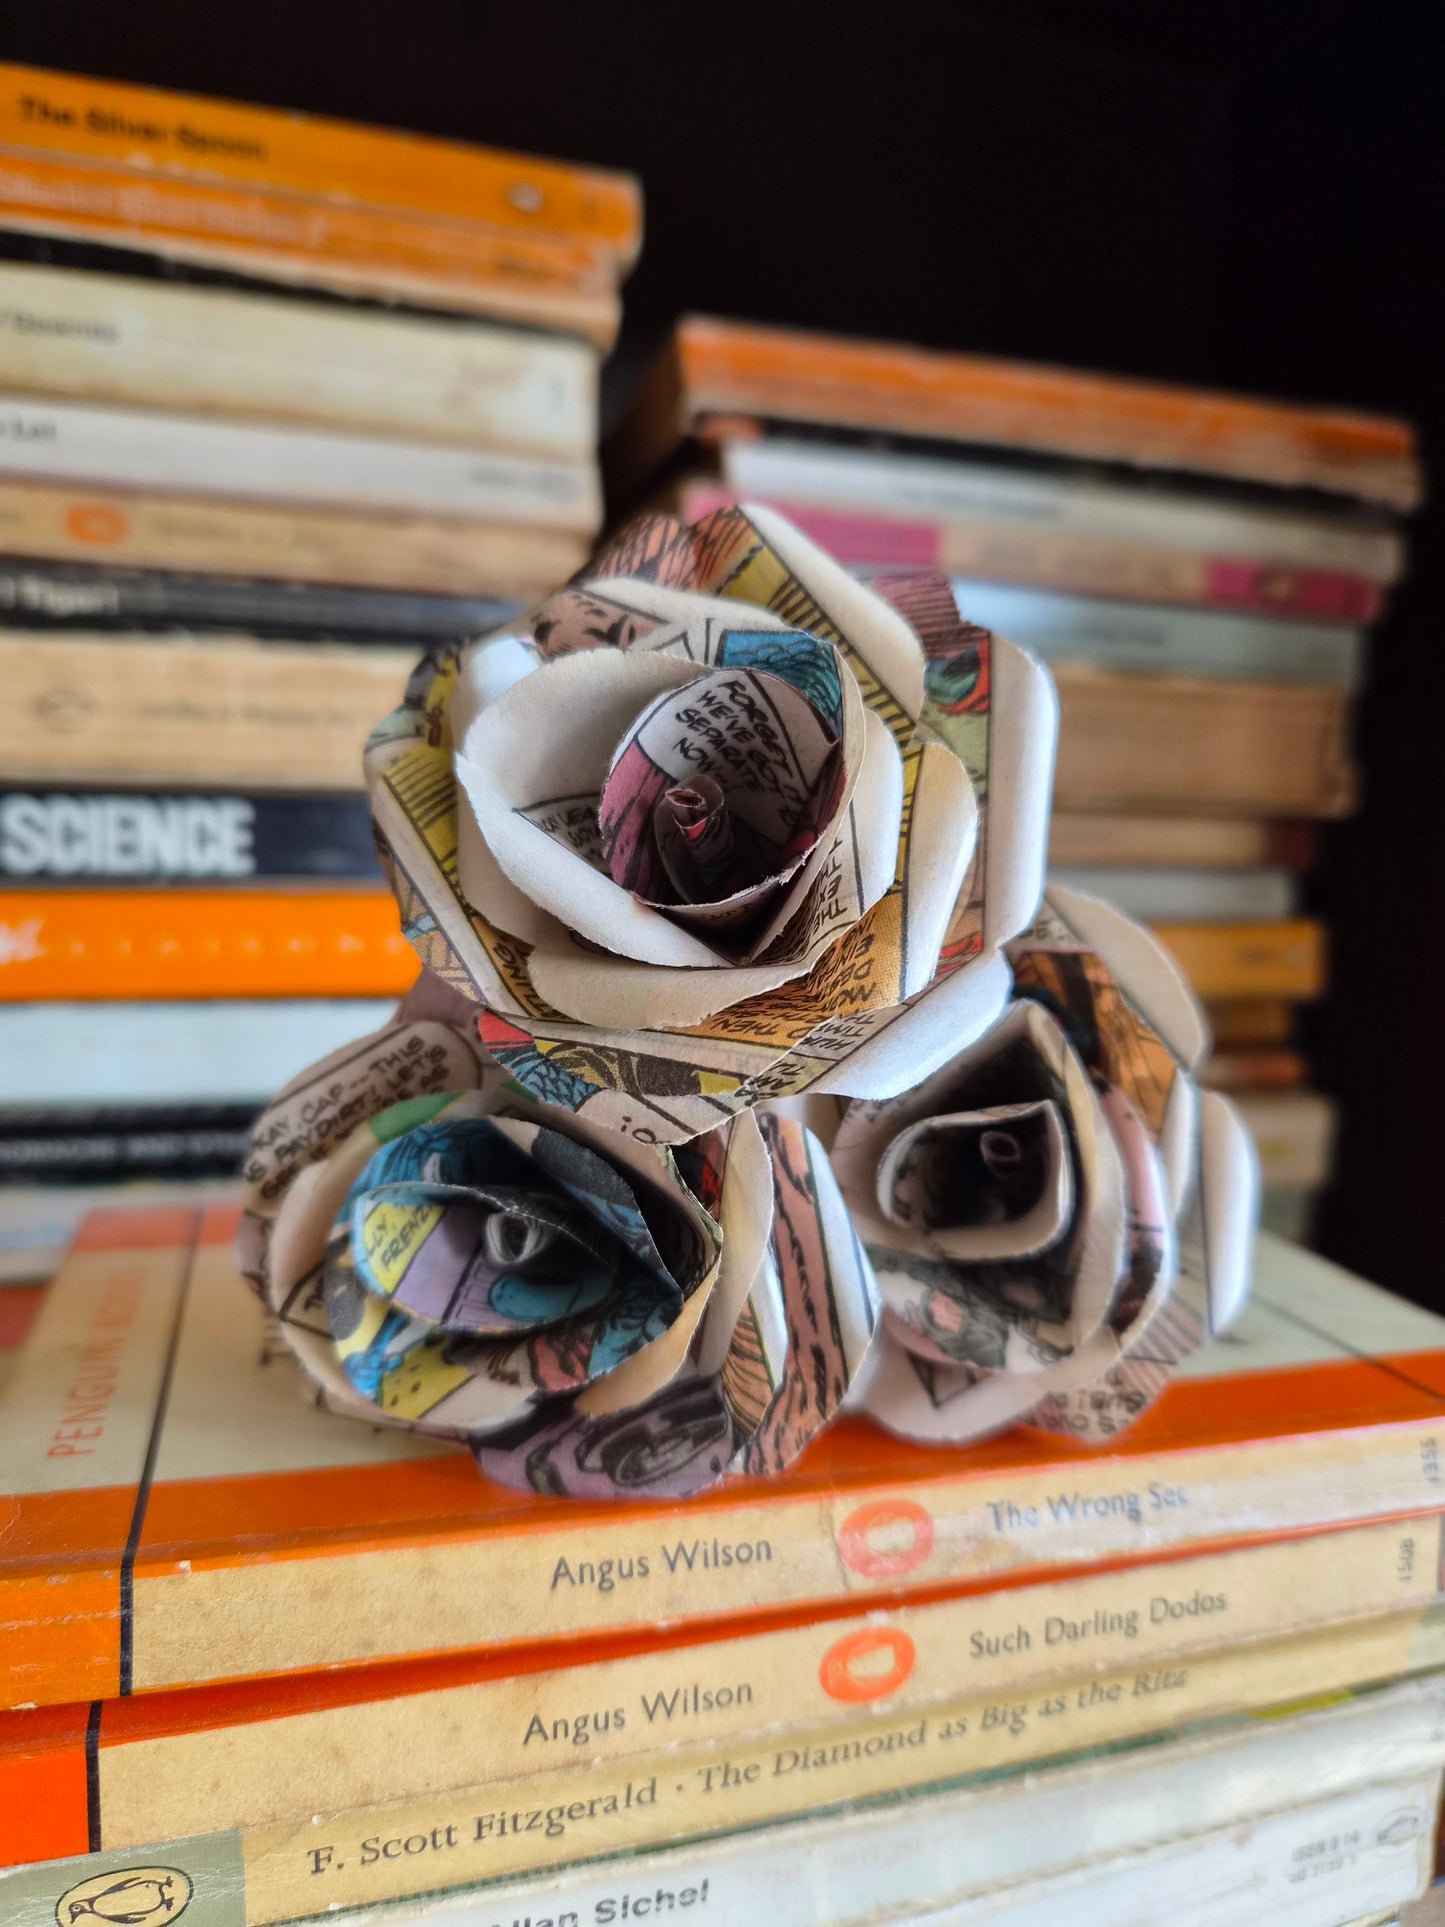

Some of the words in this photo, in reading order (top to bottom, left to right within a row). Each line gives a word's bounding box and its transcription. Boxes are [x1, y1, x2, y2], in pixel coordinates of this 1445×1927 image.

[675, 708, 767, 793] SEPARATE
[697, 690, 755, 744] WE'VE
[717, 679, 793, 778] FORGET
[3, 794, 256, 876] SCIENCE
[368, 1035, 426, 1074] THIS
[551, 1555, 650, 1592] Angus
[661, 1537, 772, 1574] Wilson
[986, 1500, 1038, 1532] The
[1046, 1491, 1142, 1524] Wrong
[523, 1707, 626, 1745] Angus
[641, 1682, 753, 1722] Wilson
[969, 1623, 1031, 1659] Such
[1044, 1609, 1139, 1645] Darling
[1149, 1590, 1228, 1624] Dodos
[307, 1845, 345, 1875] F.
[360, 1823, 458, 1866] Scott
[473, 1776, 658, 1838] Fitzgerald
[697, 1760, 761, 1793] The
[772, 1720, 927, 1777] Diamond
[938, 1716, 968, 1740] as
[980, 1703, 1028, 1734] Big
[1037, 1694, 1067, 1718] as
[1076, 1680, 1123, 1709] the
[1131, 1668, 1188, 1698] Ritz
[594, 1878, 709, 1924] Sichel
